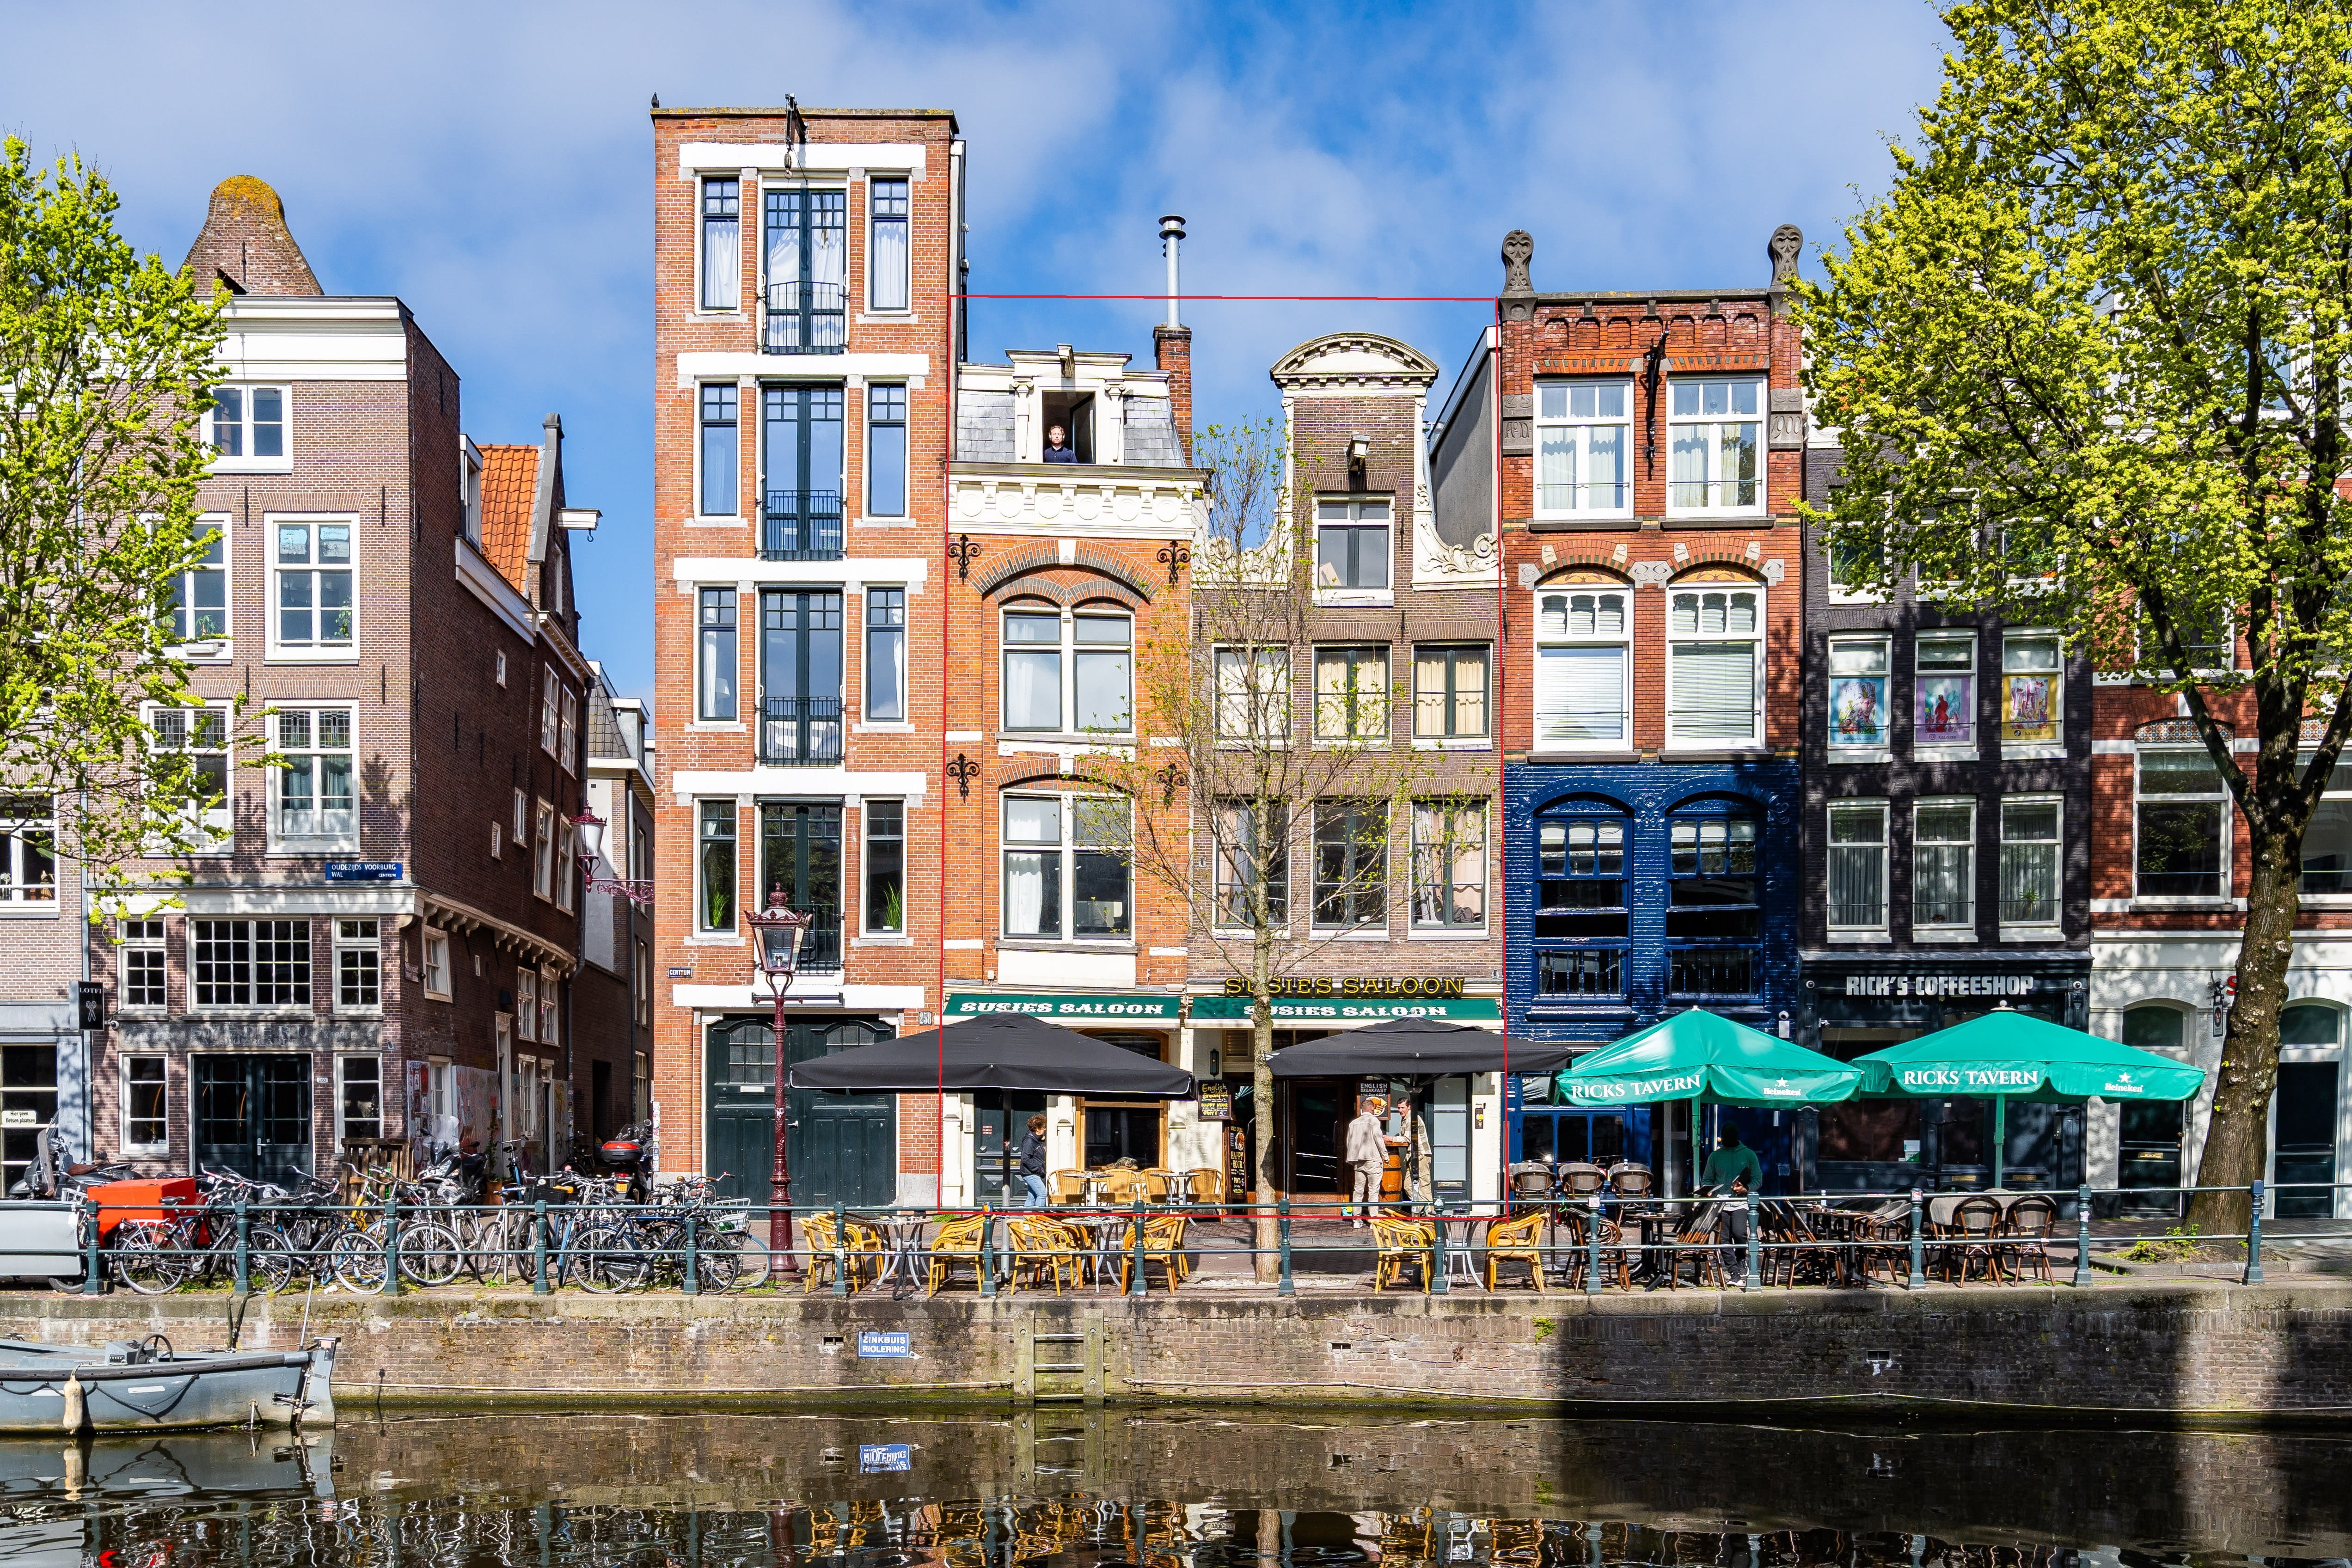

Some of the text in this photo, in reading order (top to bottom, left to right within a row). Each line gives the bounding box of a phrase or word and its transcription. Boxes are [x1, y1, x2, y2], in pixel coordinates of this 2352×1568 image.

[1771, 416, 1801, 438] 1900
[1343, 977, 1464, 994] SALOON
[1846, 976, 2034, 995] RICK'S COFFEESHOP
[960, 1002, 1164, 1014] SUSIES SALOON
[1342, 1006, 1448, 1016] SALOON
[1904, 1071, 2039, 1084] RICKS TAVERN
[1202, 1083, 1227, 1093] English
[1571, 1075, 1701, 1098] RICKS TAVERN
[1763, 1087, 1801, 1096] Heineken
[2104, 1083, 2143, 1092] Heineken
[1231, 1151, 1243, 1160] HAPPY
[1233, 1160, 1243, 1169] HOUR
